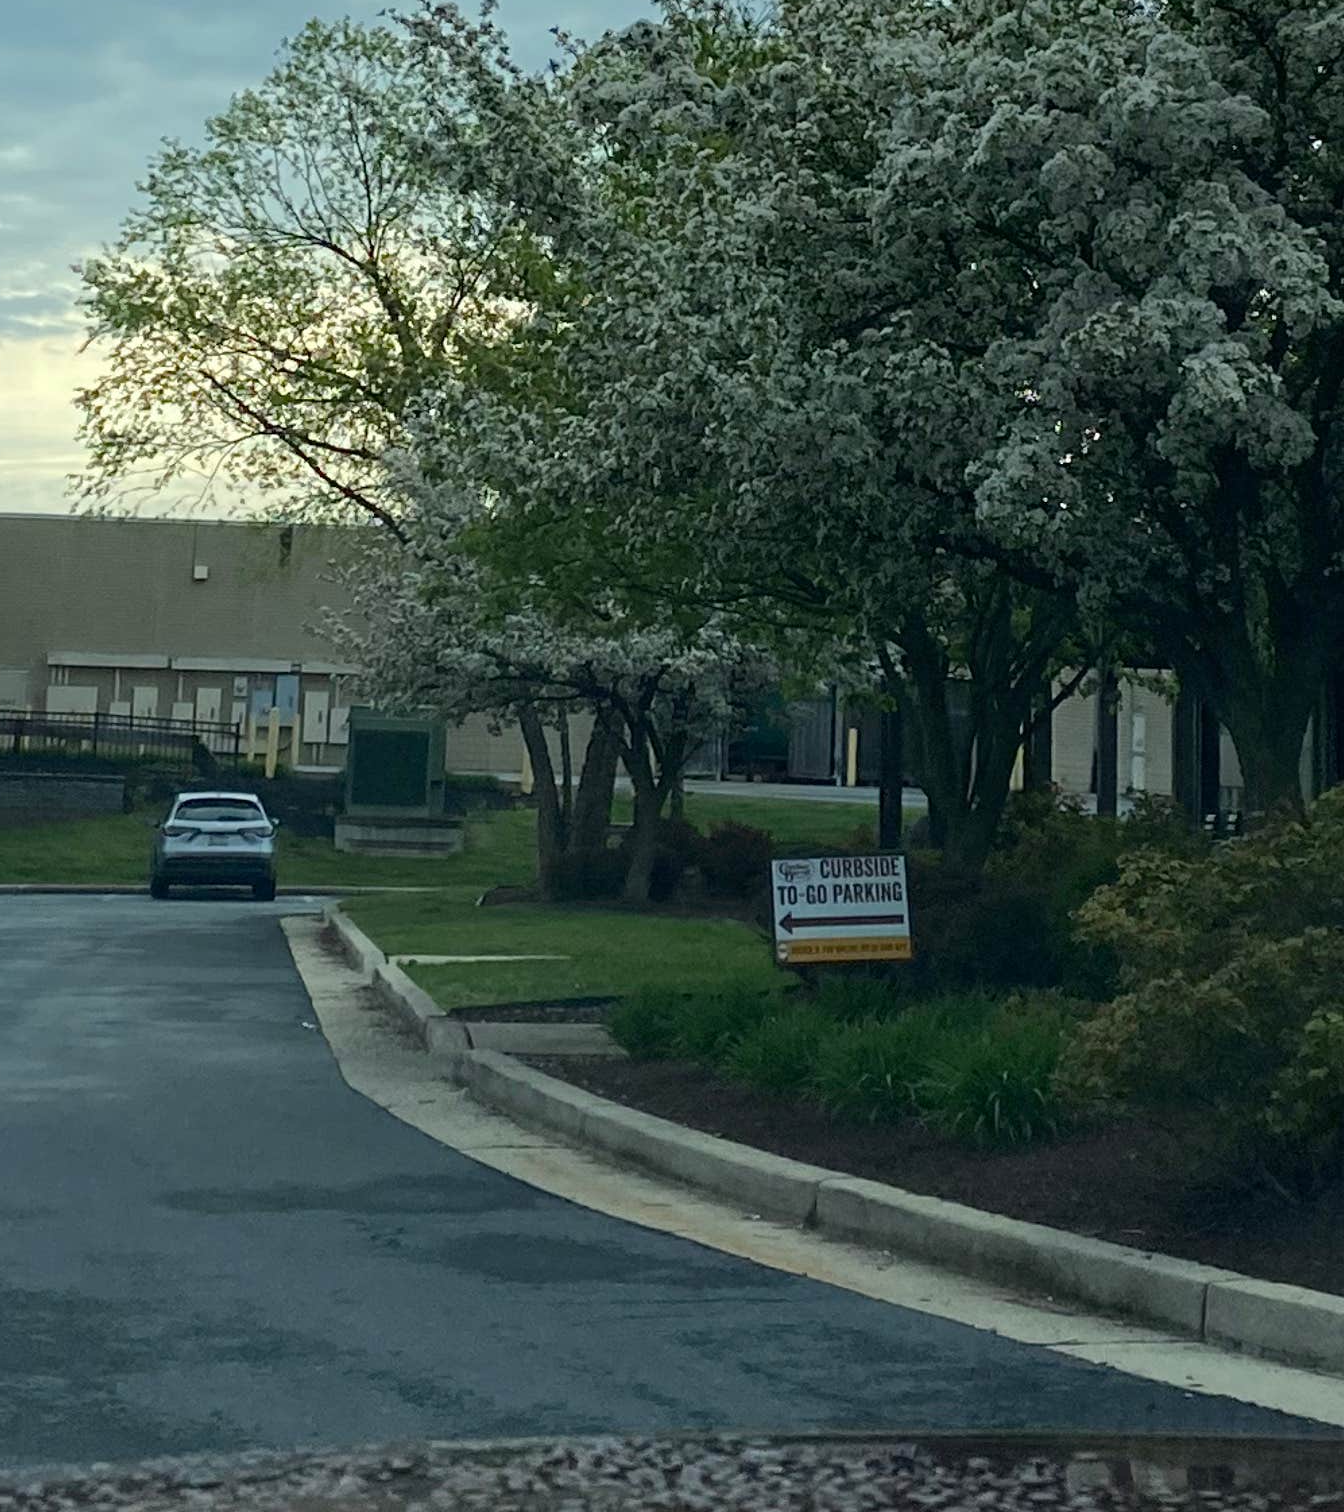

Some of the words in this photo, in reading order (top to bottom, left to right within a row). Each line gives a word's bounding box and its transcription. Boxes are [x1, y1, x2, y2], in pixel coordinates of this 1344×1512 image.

[820, 857, 900, 879] CURBSIDE
[777, 884, 827, 906] TO-GO
[833, 882, 903, 903] PARKING
